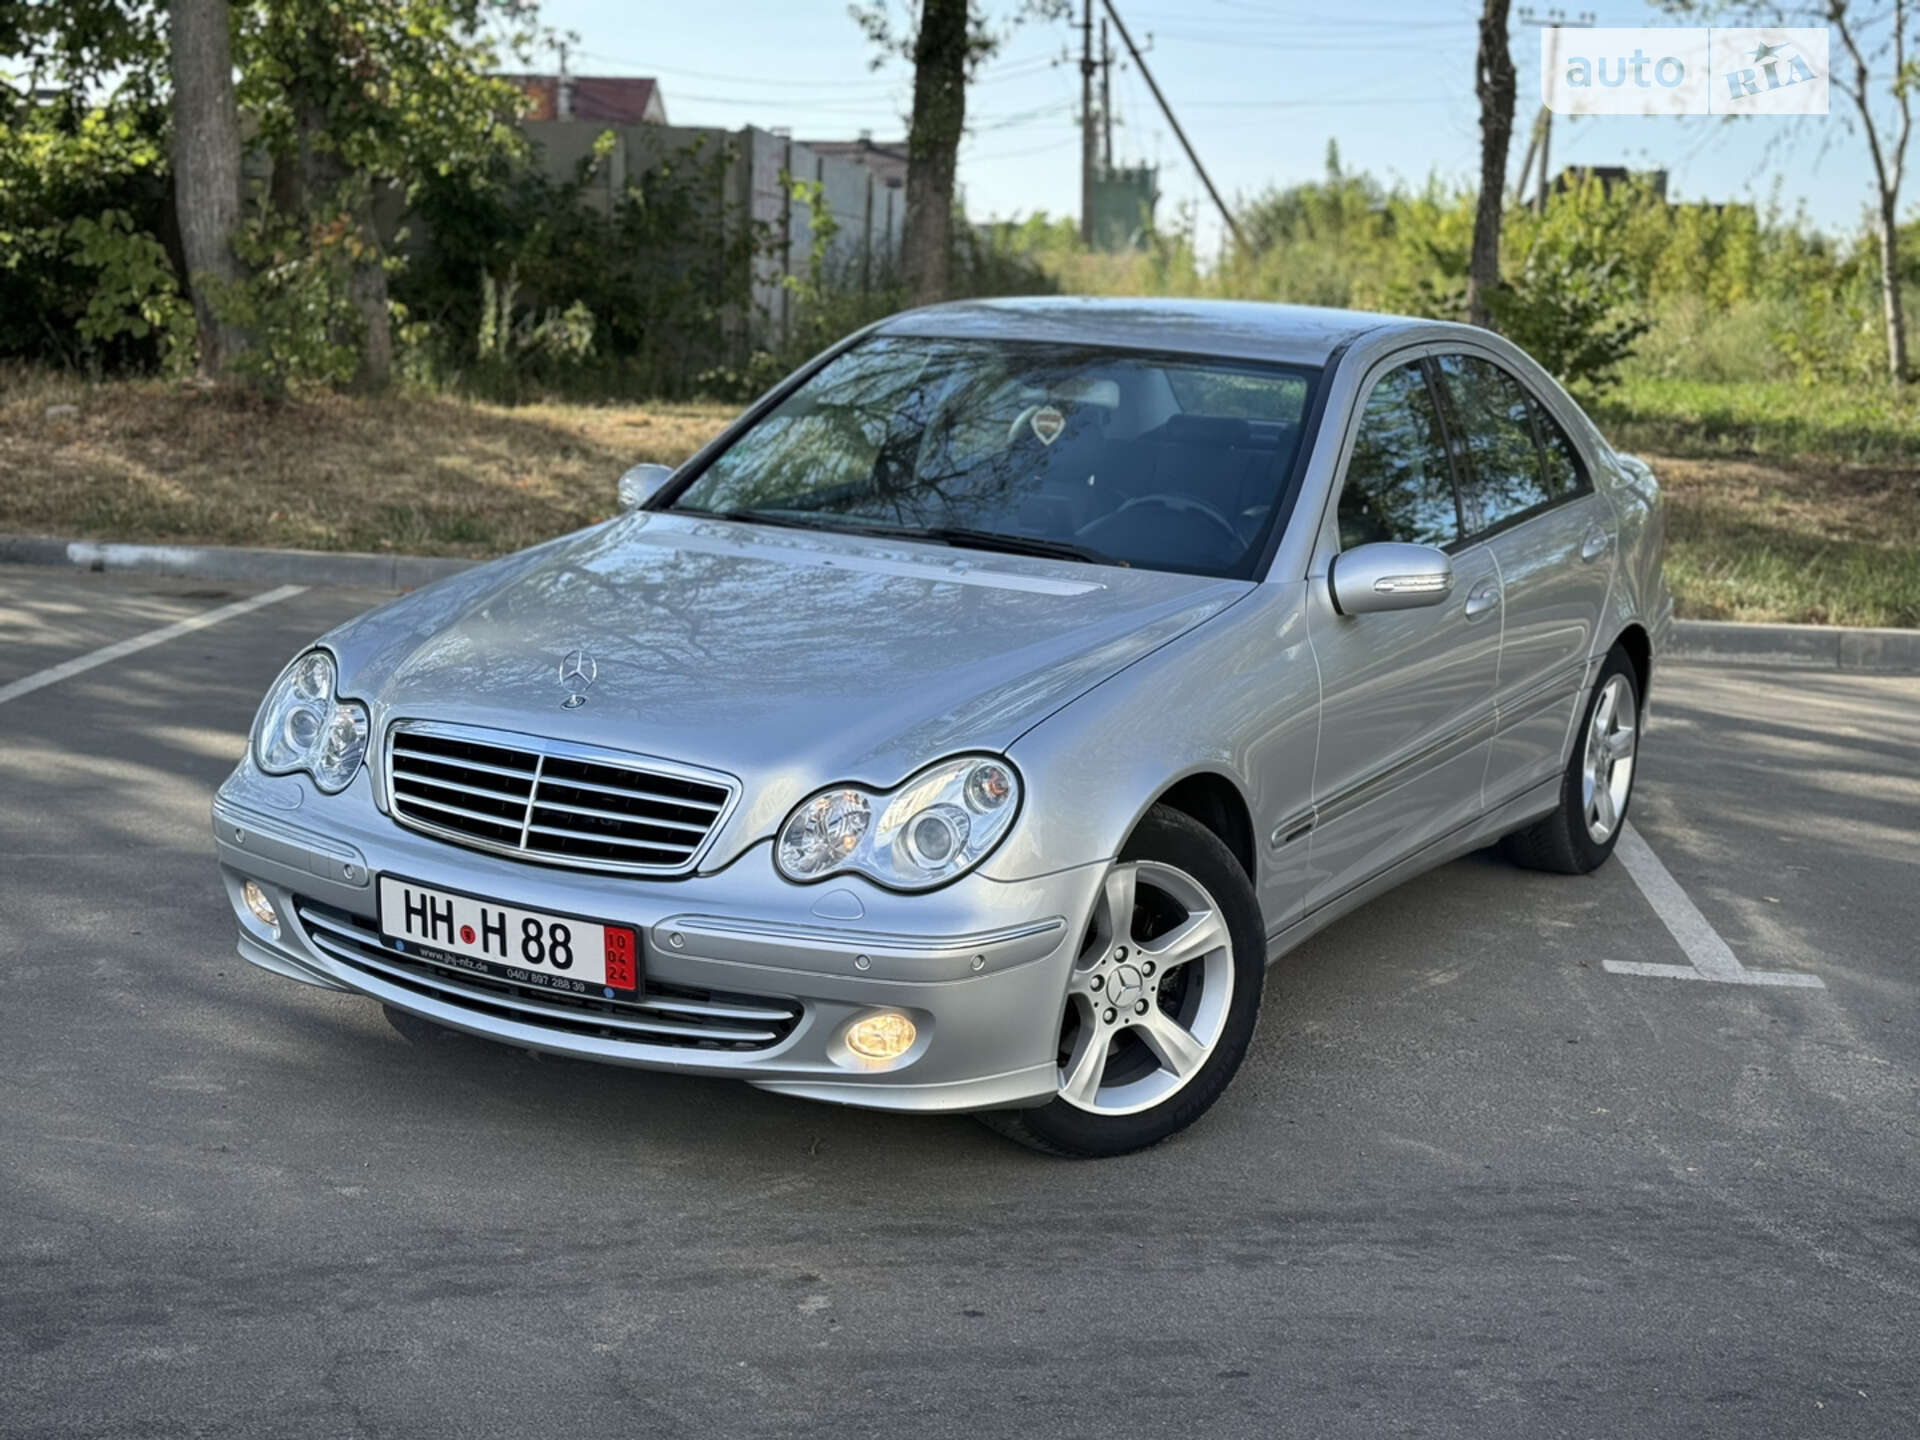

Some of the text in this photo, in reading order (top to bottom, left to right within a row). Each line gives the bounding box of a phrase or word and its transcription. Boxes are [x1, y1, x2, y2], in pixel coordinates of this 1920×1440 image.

[404, 889, 573, 970] HH H 88
[608, 934, 626, 949] 10
[608, 950, 627, 965] 04
[608, 966, 628, 981] 24
[531, 973, 549, 985] 897
[551, 978, 570, 989] 288
[572, 981, 585, 993] 39
